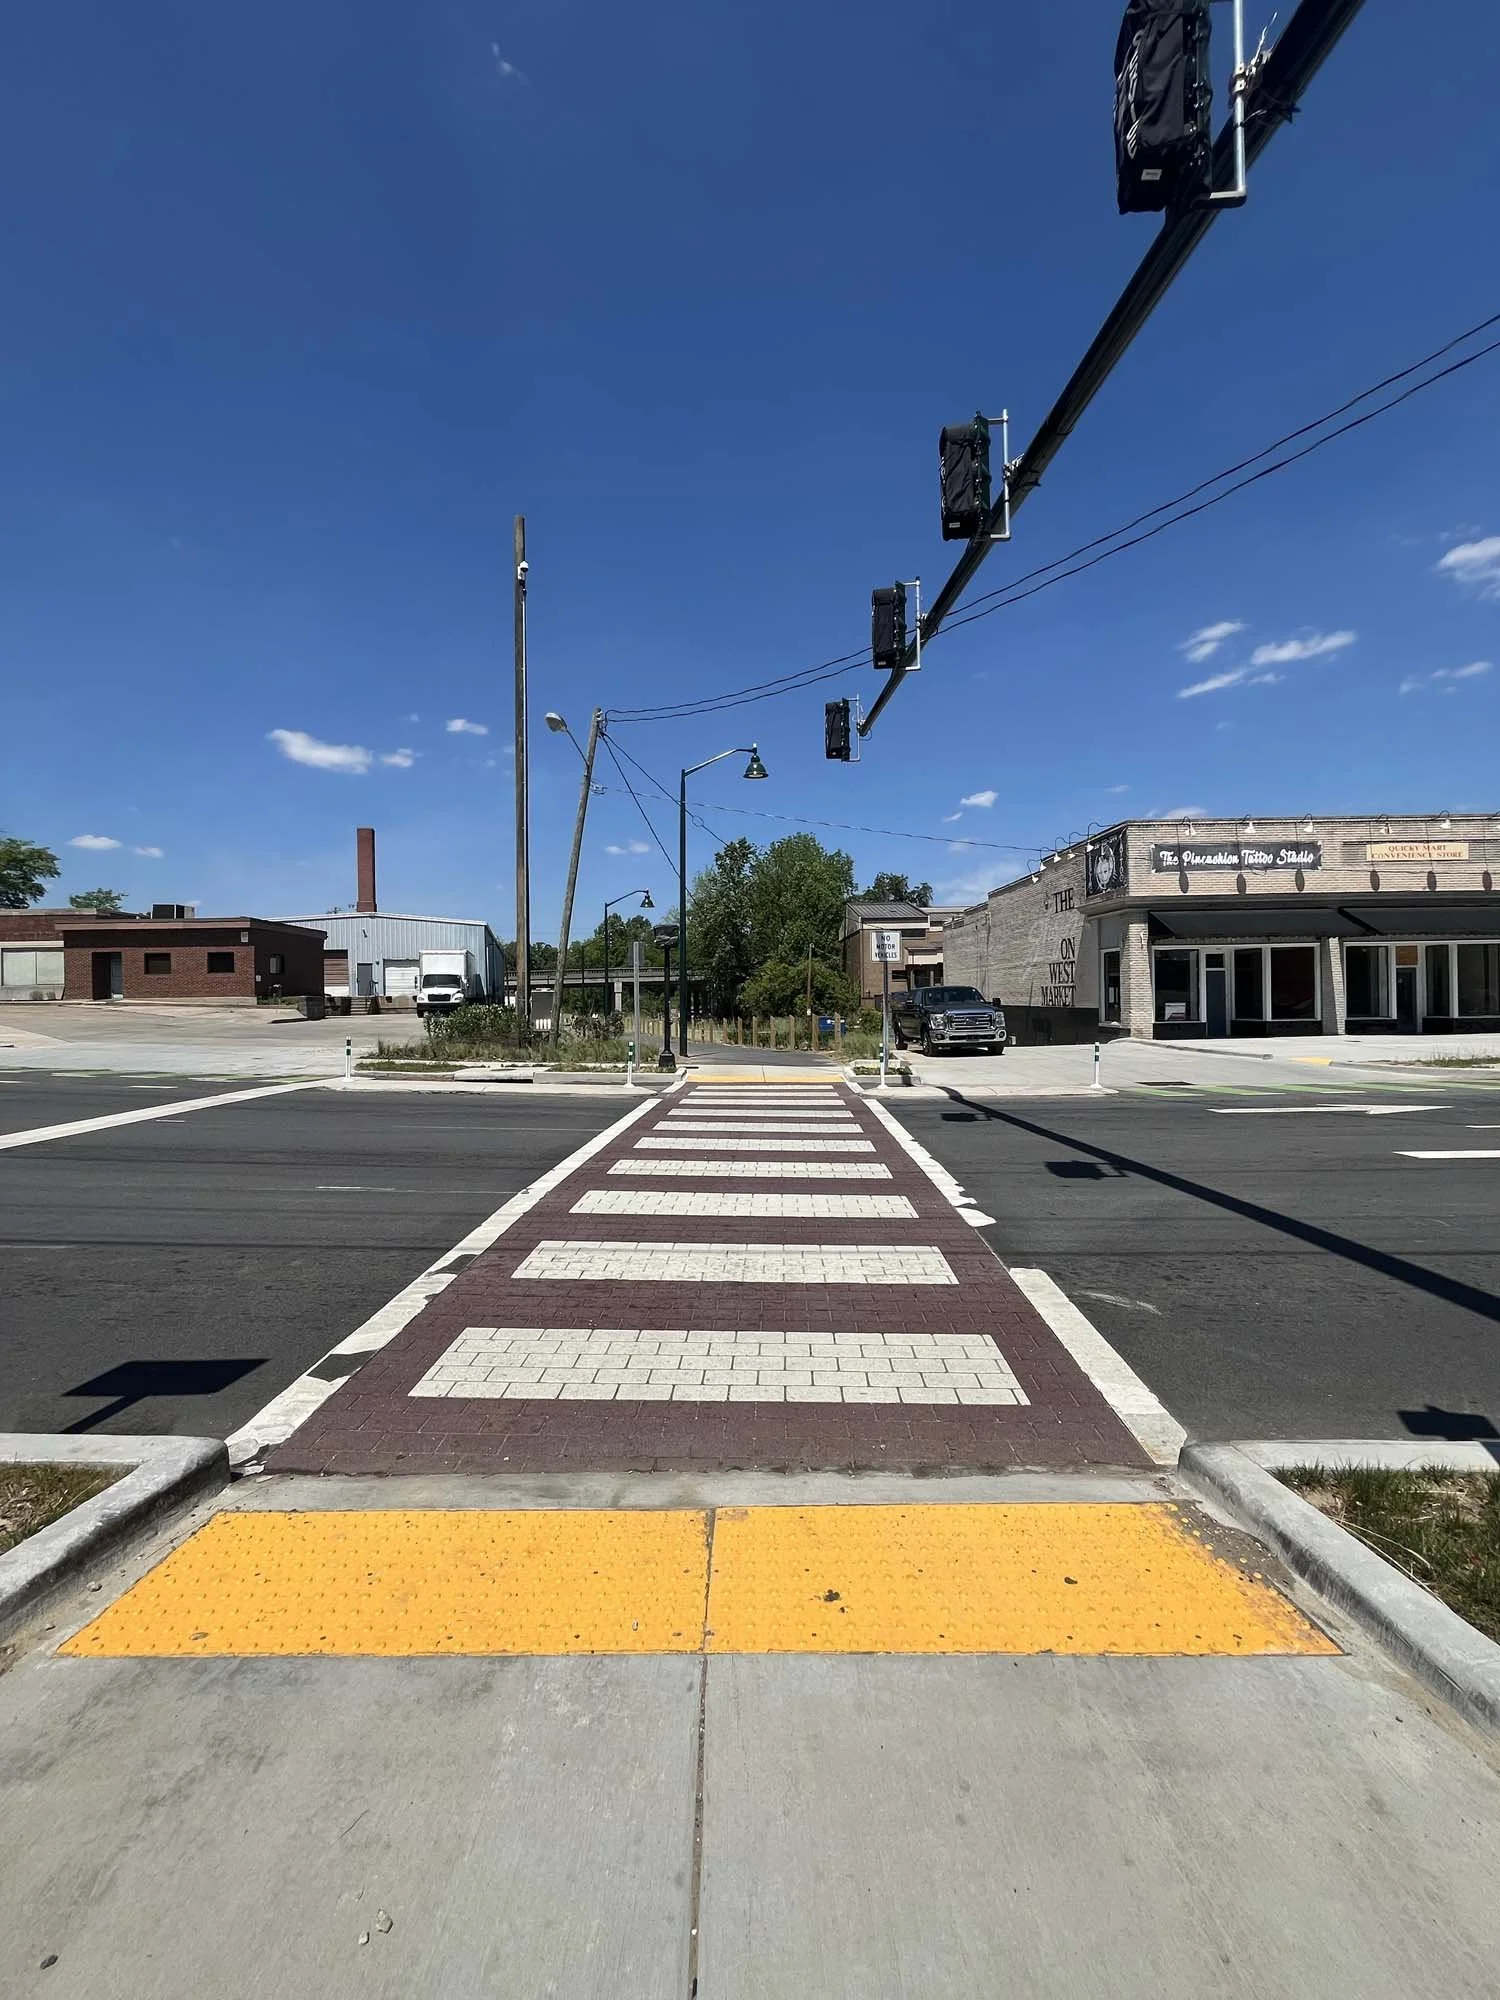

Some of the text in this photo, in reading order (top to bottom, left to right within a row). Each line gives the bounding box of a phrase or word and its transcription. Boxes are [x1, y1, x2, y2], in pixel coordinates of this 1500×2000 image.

[1160, 848, 1314, 867] The Pincushion Tattoo Studio
[1051, 887, 1074, 914] THE
[1060, 937, 1076, 960] ON
[1048, 960, 1076, 985] WEST
[1041, 985, 1077, 1008] MARKET
